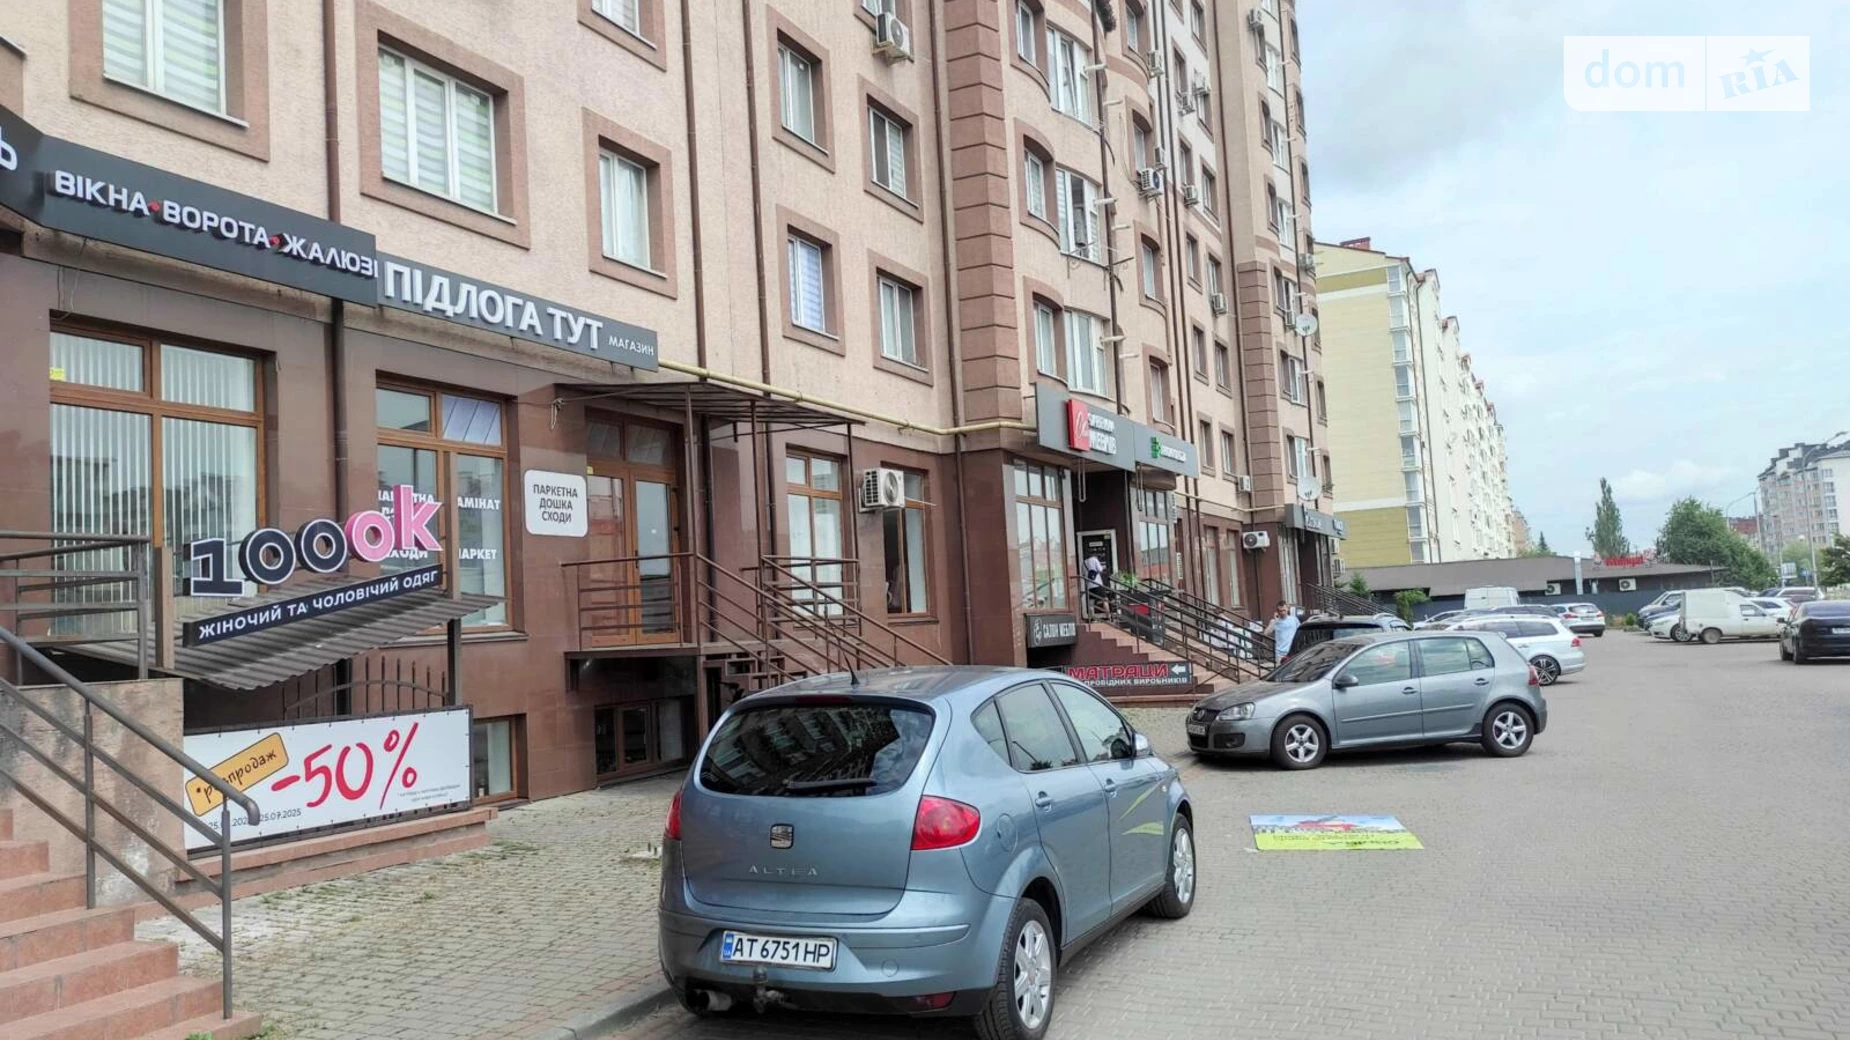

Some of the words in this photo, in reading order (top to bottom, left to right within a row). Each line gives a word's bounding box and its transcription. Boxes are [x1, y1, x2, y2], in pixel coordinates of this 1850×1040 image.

[55, 170, 150, 216] ВІКНА
[163, 200, 271, 248] ВОРОТА
[282, 233, 379, 278] ЖАЛЮЗІ
[384, 261, 544, 336] ПІДЛОГА
[547, 307, 603, 350] ТУТ
[608, 335, 655, 356] МАГАЗИН
[533, 484, 578, 498] ПАРКЕТНА
[539, 497, 573, 511] ДОШКА
[541, 511, 572, 524] СХОДИ
[199, 607, 282, 640] ЖІНОЧИЙ
[287, 602, 307, 617] ТА
[312, 577, 399, 610] ЧОЛОВІЧИЙ
[403, 570, 438, 589] ОДЯГ
[1067, 663, 1169, 681] МАТРАЦИ
[271, 721, 419, 811] -50%
